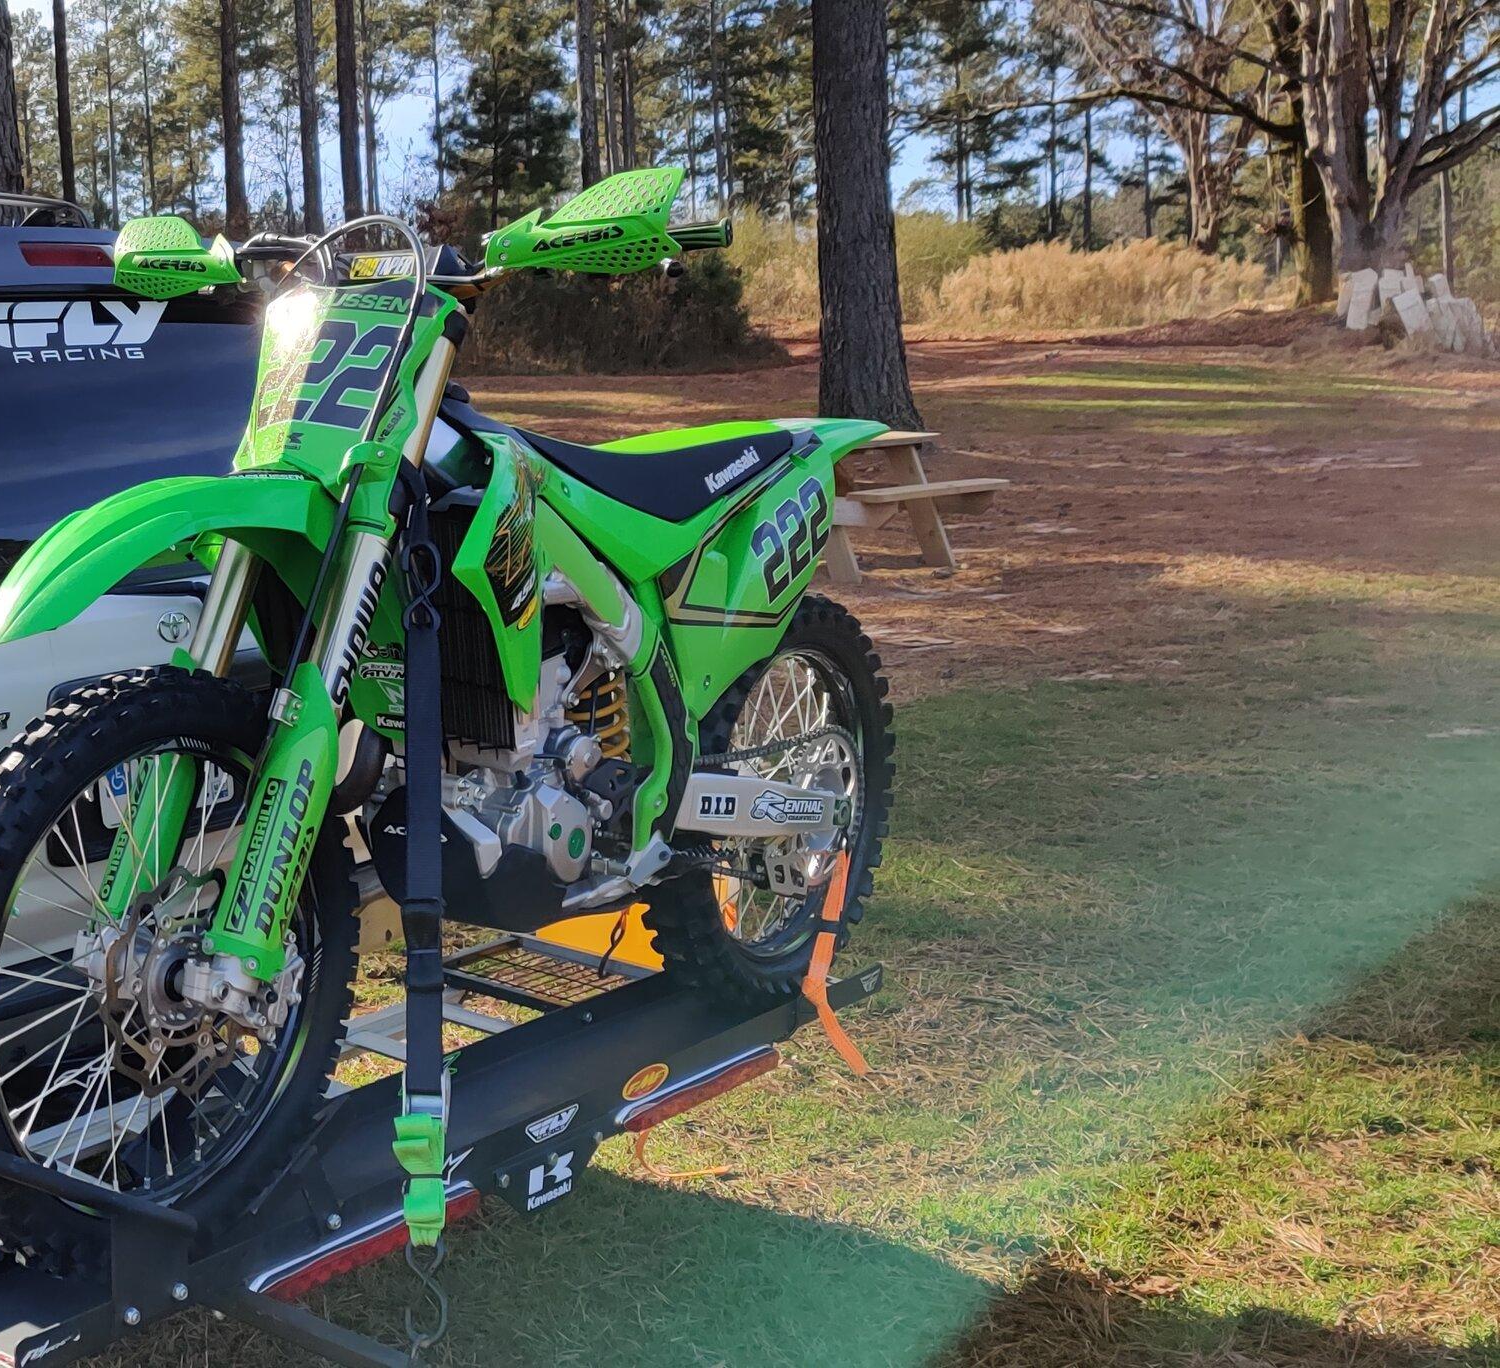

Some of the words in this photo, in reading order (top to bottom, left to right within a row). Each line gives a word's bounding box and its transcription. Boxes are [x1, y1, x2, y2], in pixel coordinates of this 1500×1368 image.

[532, 225, 624, 253] ACERBIS
[137, 258, 207, 272] ACERBIS
[12, 347, 146, 364] RACING
[704, 446, 761, 494] Kawasaki
[750, 476, 830, 606] 222
[331, 561, 388, 706] SHOWA
[241, 779, 283, 883] CARRILLO
[255, 758, 316, 940] DUNLOP
[527, 1179, 573, 1212] Kawasaki
